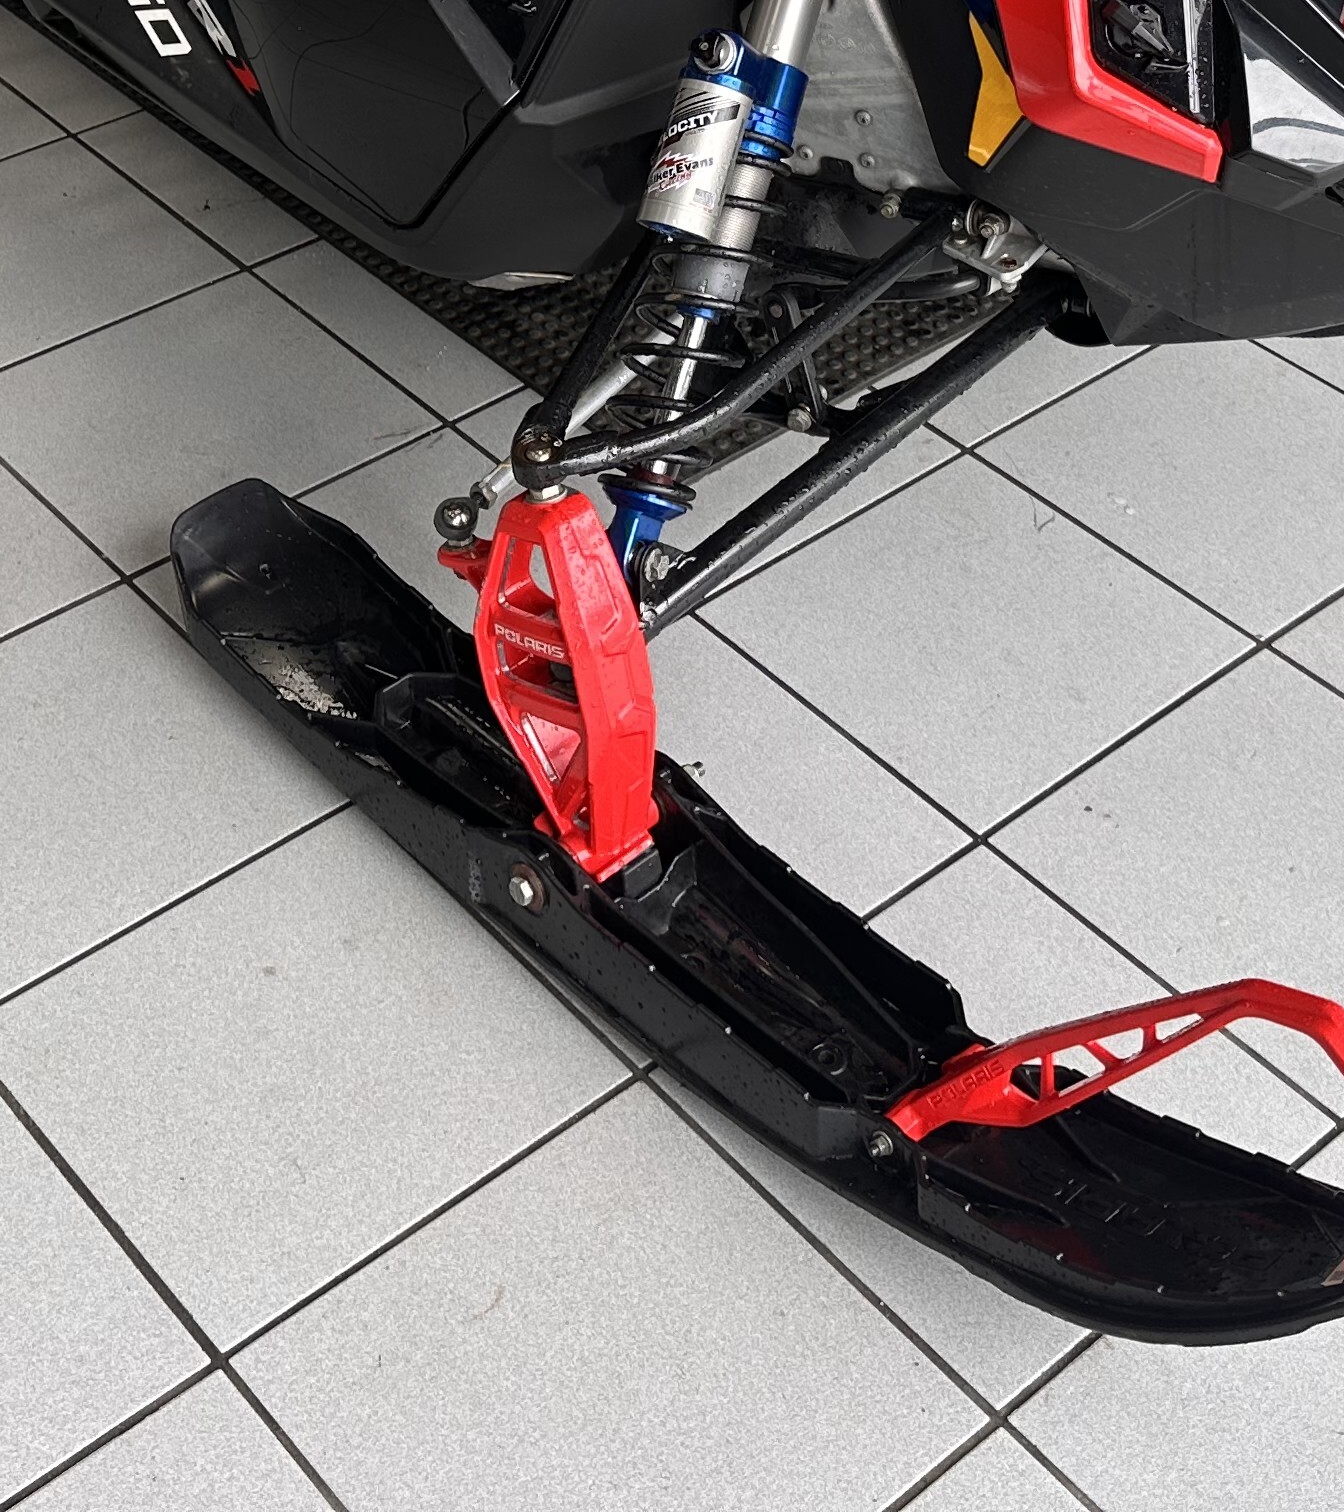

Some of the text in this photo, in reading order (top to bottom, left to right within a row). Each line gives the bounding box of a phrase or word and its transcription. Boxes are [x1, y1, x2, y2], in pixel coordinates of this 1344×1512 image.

[662, 111, 718, 141] LOCITY
[494, 624, 565, 658] POLARIS
[926, 1060, 1004, 1110] POLARIS
